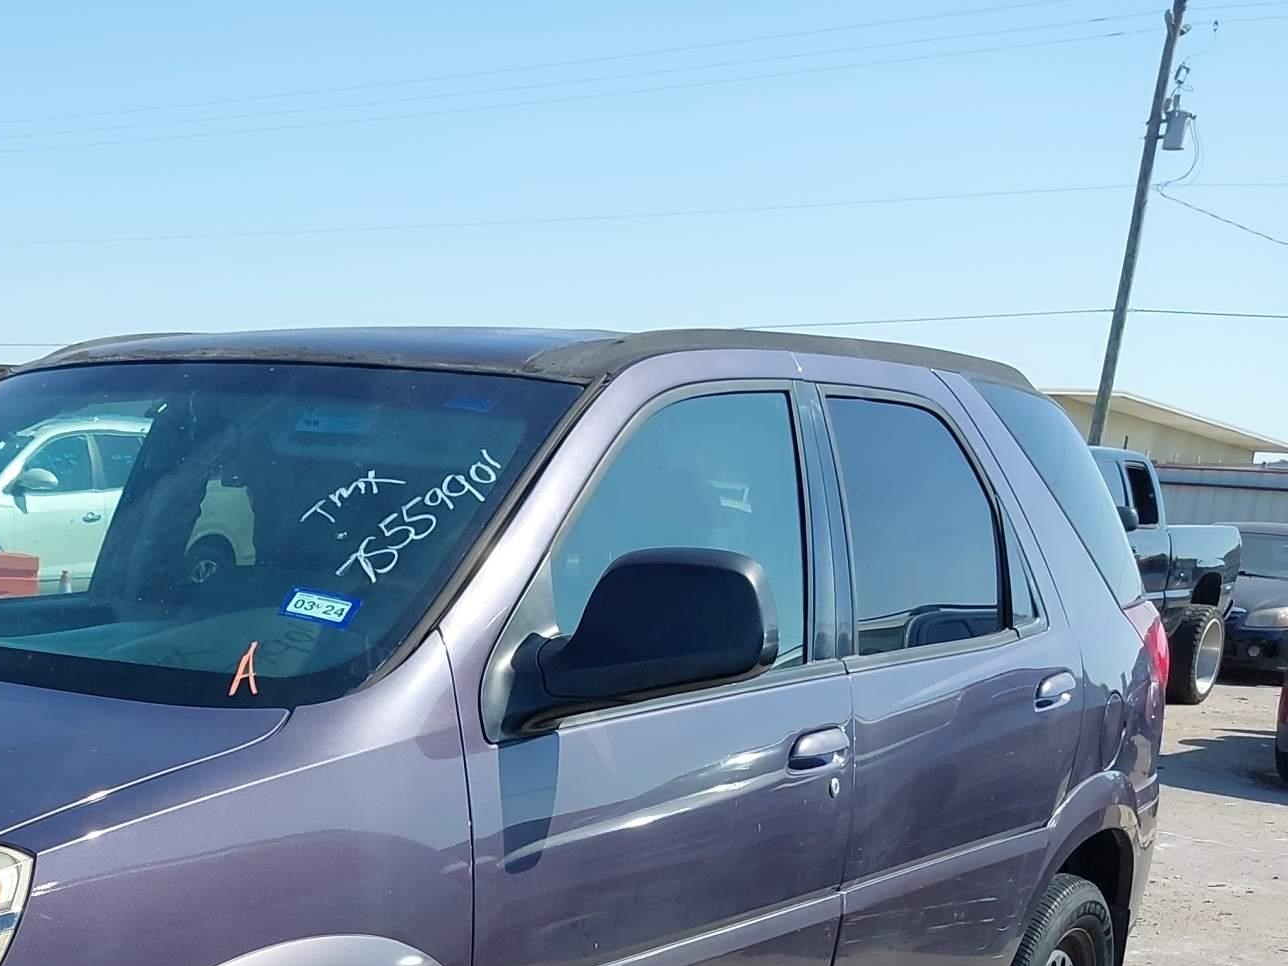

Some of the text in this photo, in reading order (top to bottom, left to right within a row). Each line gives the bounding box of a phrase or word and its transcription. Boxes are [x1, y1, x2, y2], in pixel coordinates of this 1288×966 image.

[293, 599, 316, 611] 03
[322, 604, 346, 618] 24
[228, 640, 258, 696] A
